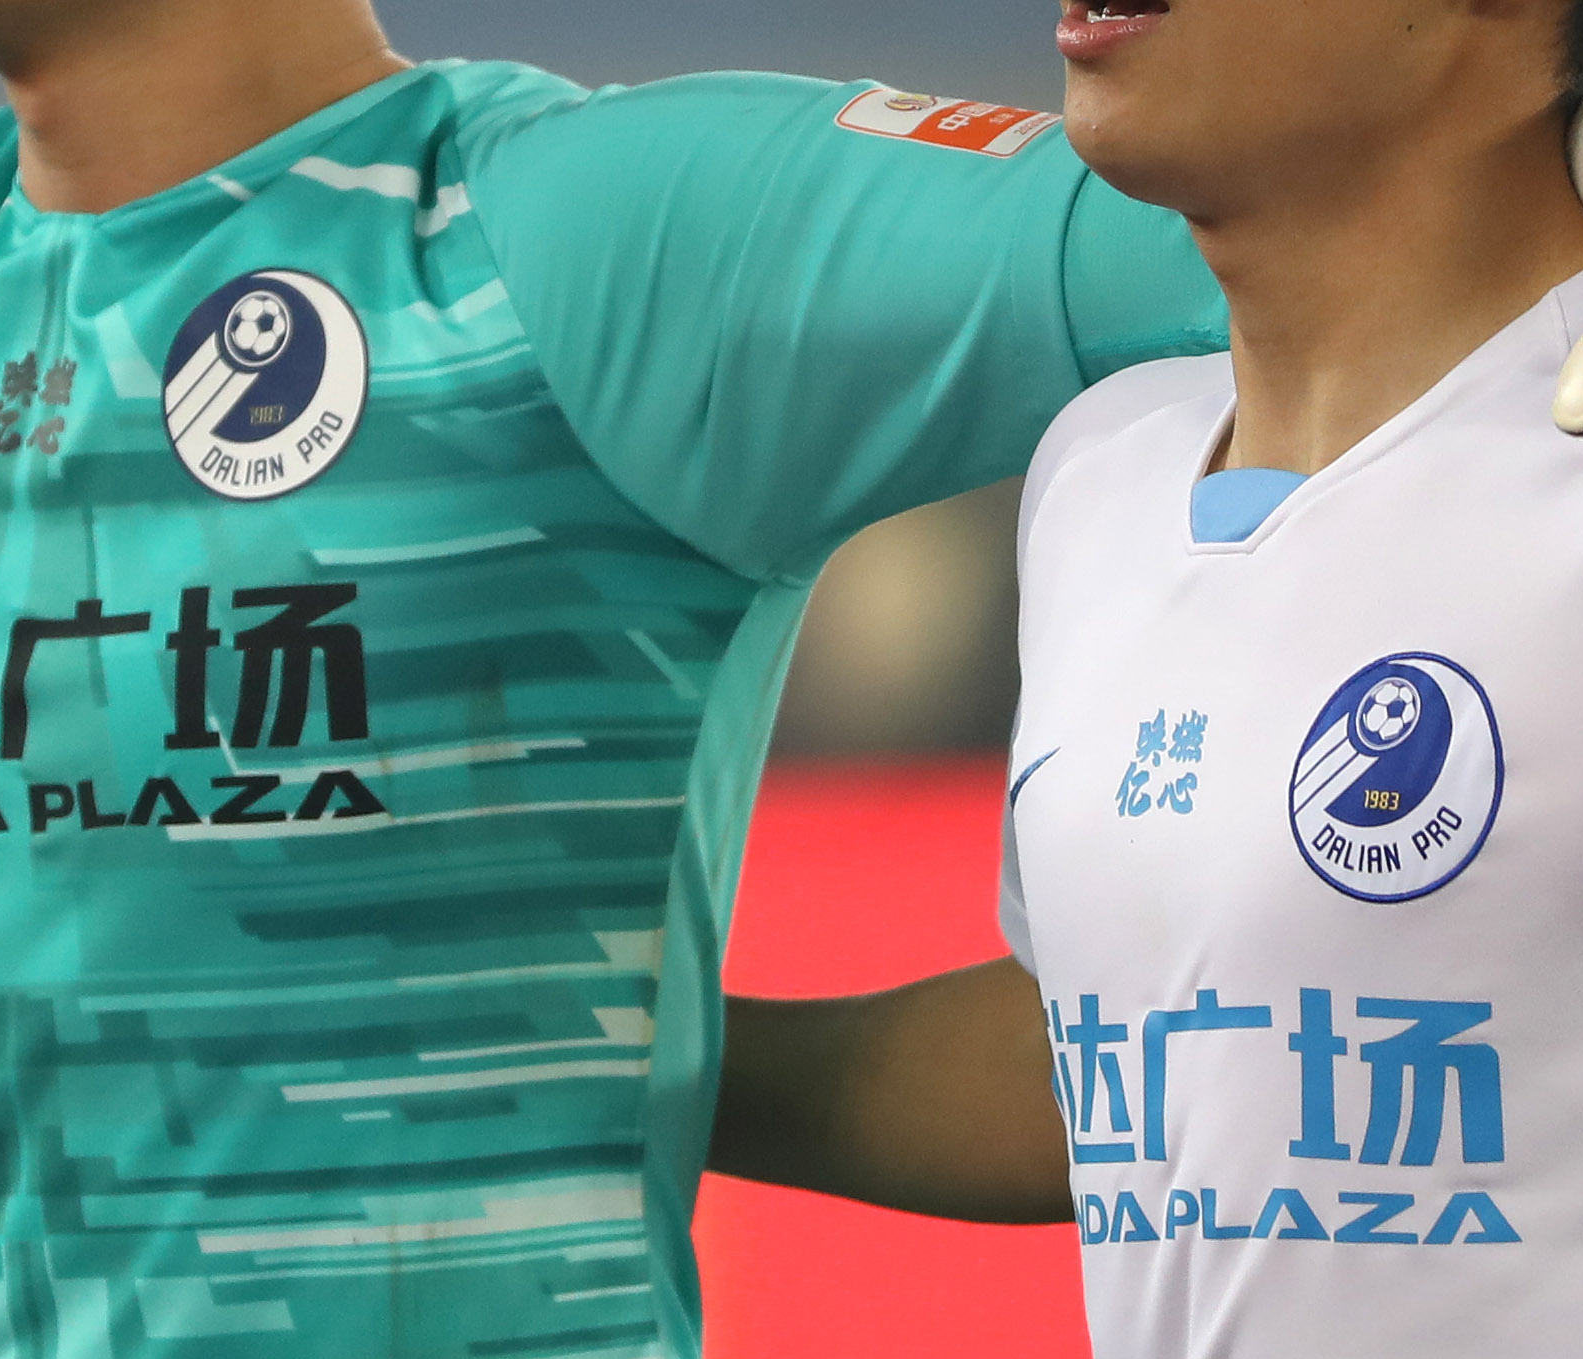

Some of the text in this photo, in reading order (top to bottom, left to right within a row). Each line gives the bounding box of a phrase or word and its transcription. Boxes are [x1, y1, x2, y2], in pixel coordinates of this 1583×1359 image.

[199, 410, 344, 486] DALIAN PRO
[28, 770, 388, 833] PLAZA
[1363, 789, 1401, 811] 1983
[1311, 805, 1463, 874] DALIAN PRO
[1044, 987, 1506, 1168] 达广场
[1165, 1187, 1524, 1246] PLAZA
